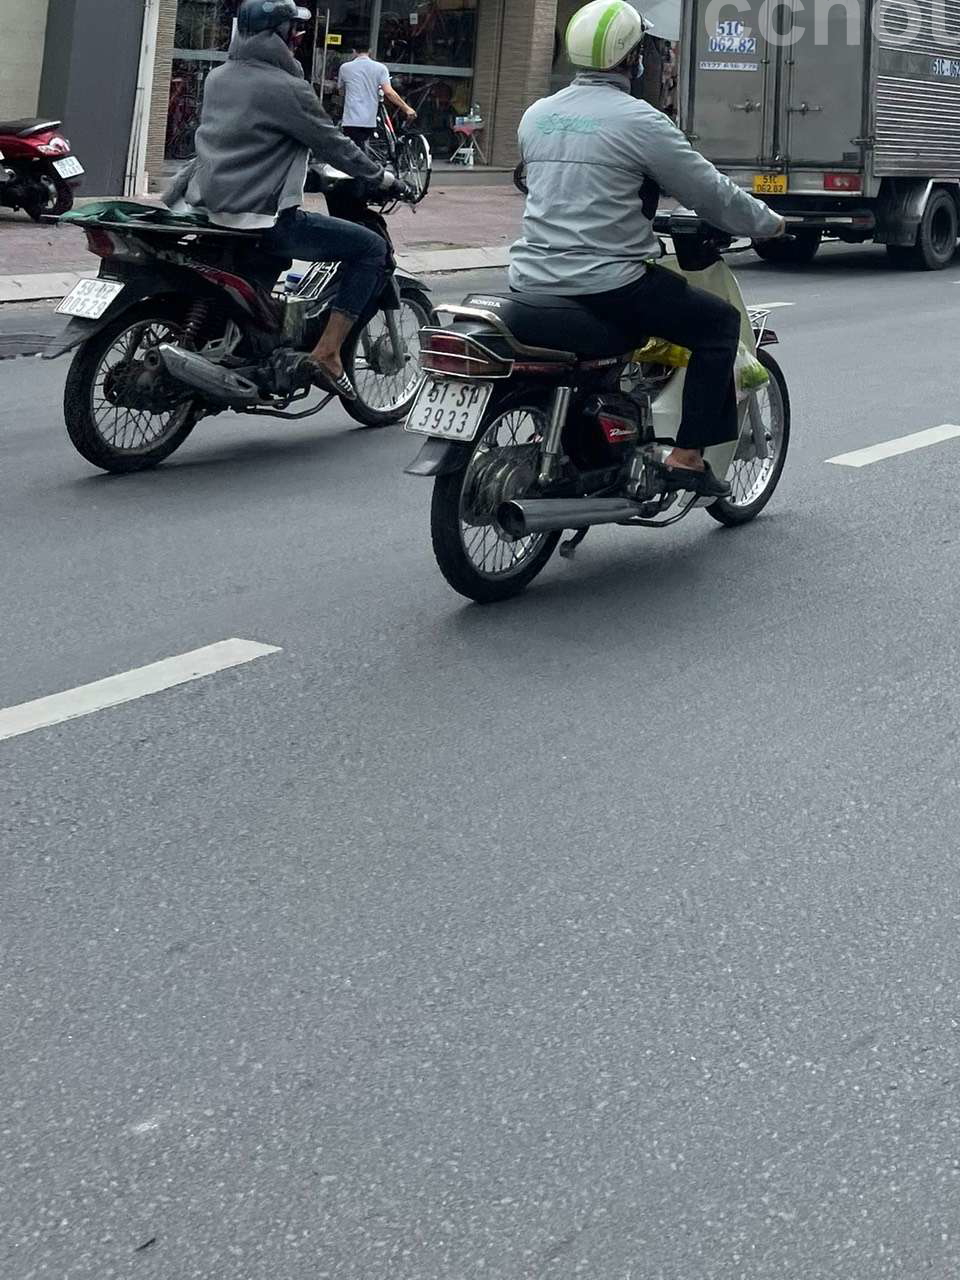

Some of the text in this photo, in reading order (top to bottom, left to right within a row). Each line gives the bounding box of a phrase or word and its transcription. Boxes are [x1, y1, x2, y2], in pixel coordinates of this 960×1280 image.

[717, 21, 744, 35] 51C
[710, 38, 755, 52] 062.82
[469, 299, 501, 308] HONDA
[419, 408, 468, 433] 3933
